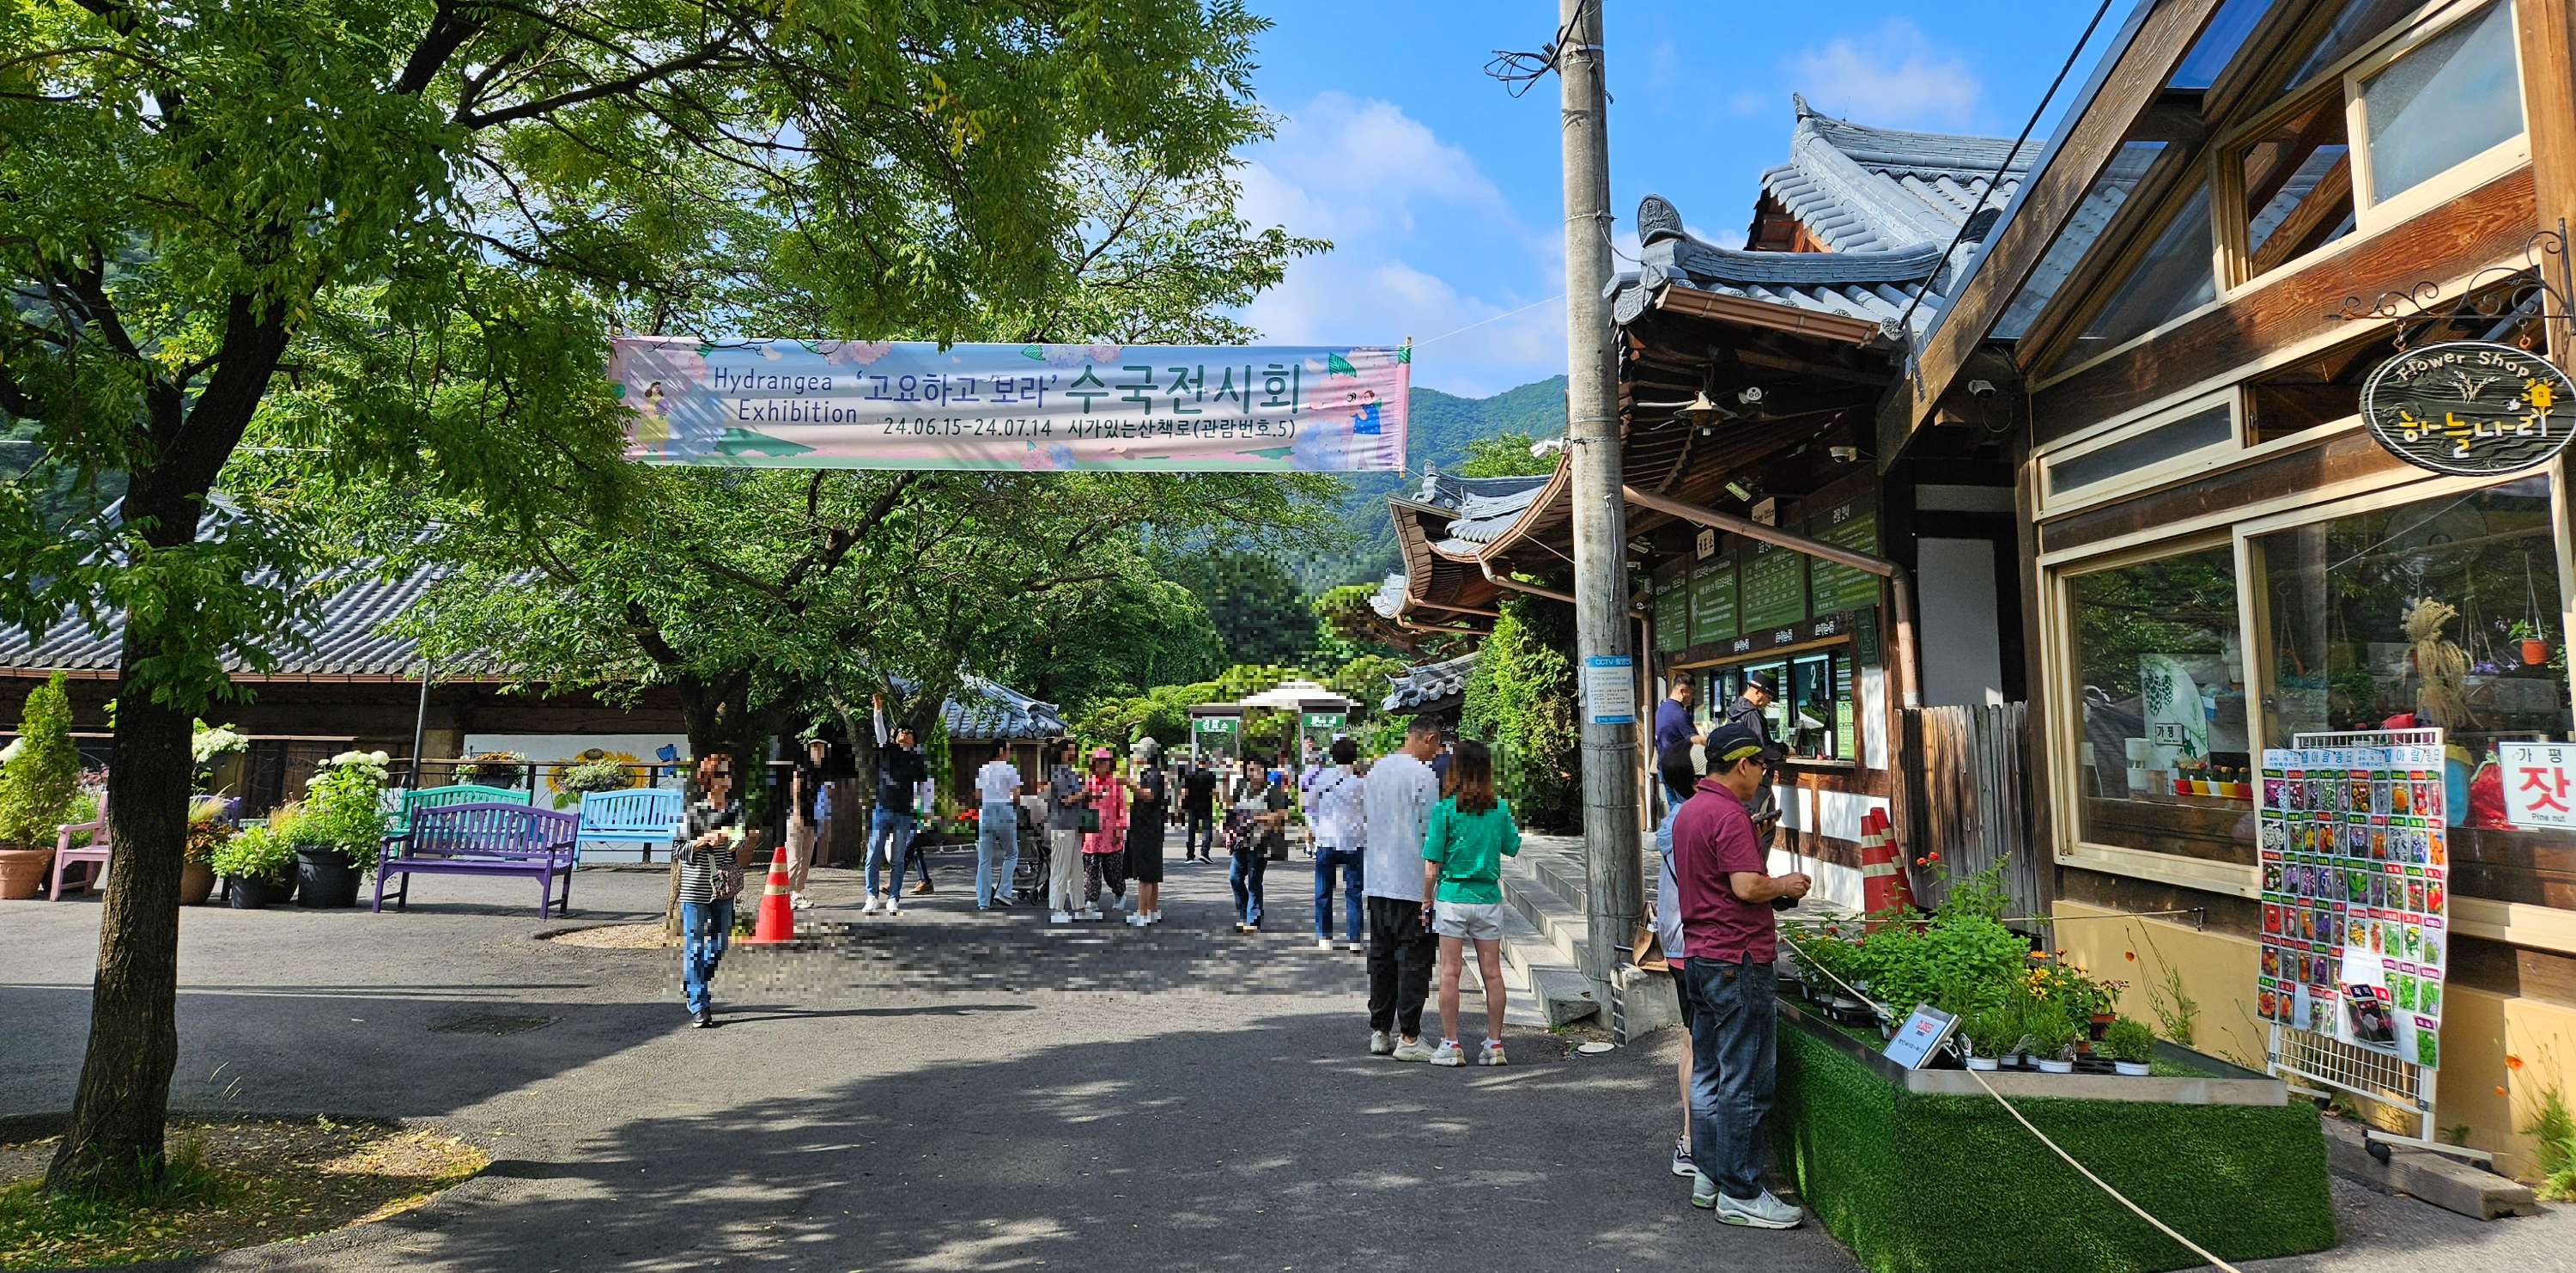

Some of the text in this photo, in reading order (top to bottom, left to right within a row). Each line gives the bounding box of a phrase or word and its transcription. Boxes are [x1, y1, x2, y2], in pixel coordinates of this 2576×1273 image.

[2396, 350, 2530, 381] Flower Shop
[714, 367, 833, 395] Hydrangea
[1065, 363, 1301, 415] 수국전시회
[738, 399, 857, 423] Exhibition
[883, 416, 1297, 441] 24.06.15-24.07.14 시가있는산책로(관람번호.5)
[2398, 410, 2549, 459] 하늘나리
[1810, 664, 1817, 689] 2
[2518, 747, 2562, 764] 가평
[2518, 766, 2571, 813] 잣
[2531, 813, 2549, 821] Pine
